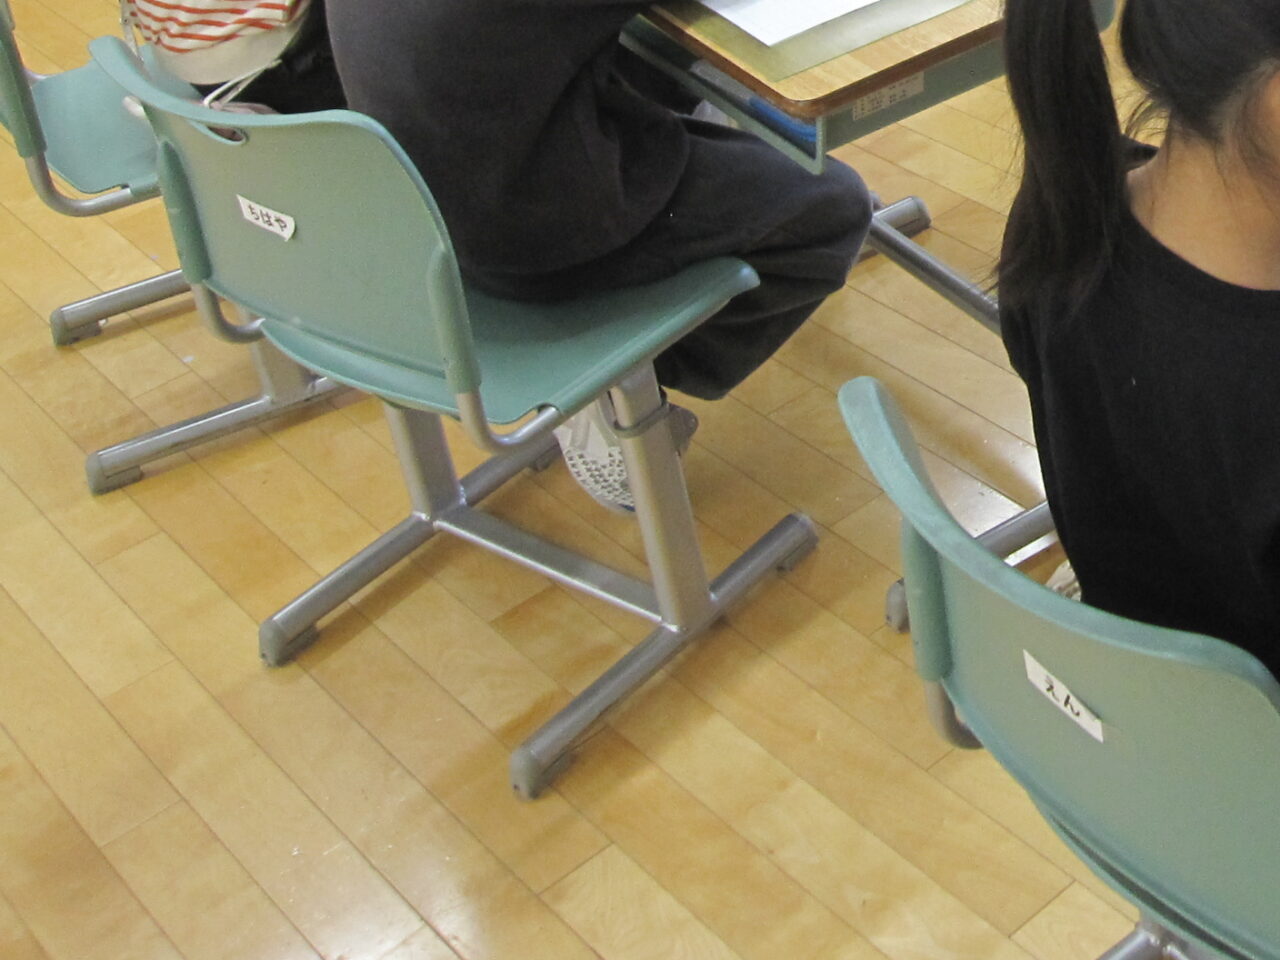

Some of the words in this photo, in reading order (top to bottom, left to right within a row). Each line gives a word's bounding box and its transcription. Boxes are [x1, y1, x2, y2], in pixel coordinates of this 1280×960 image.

[247, 204, 288, 233] ちはや
[1043, 674, 1081, 717] えん
